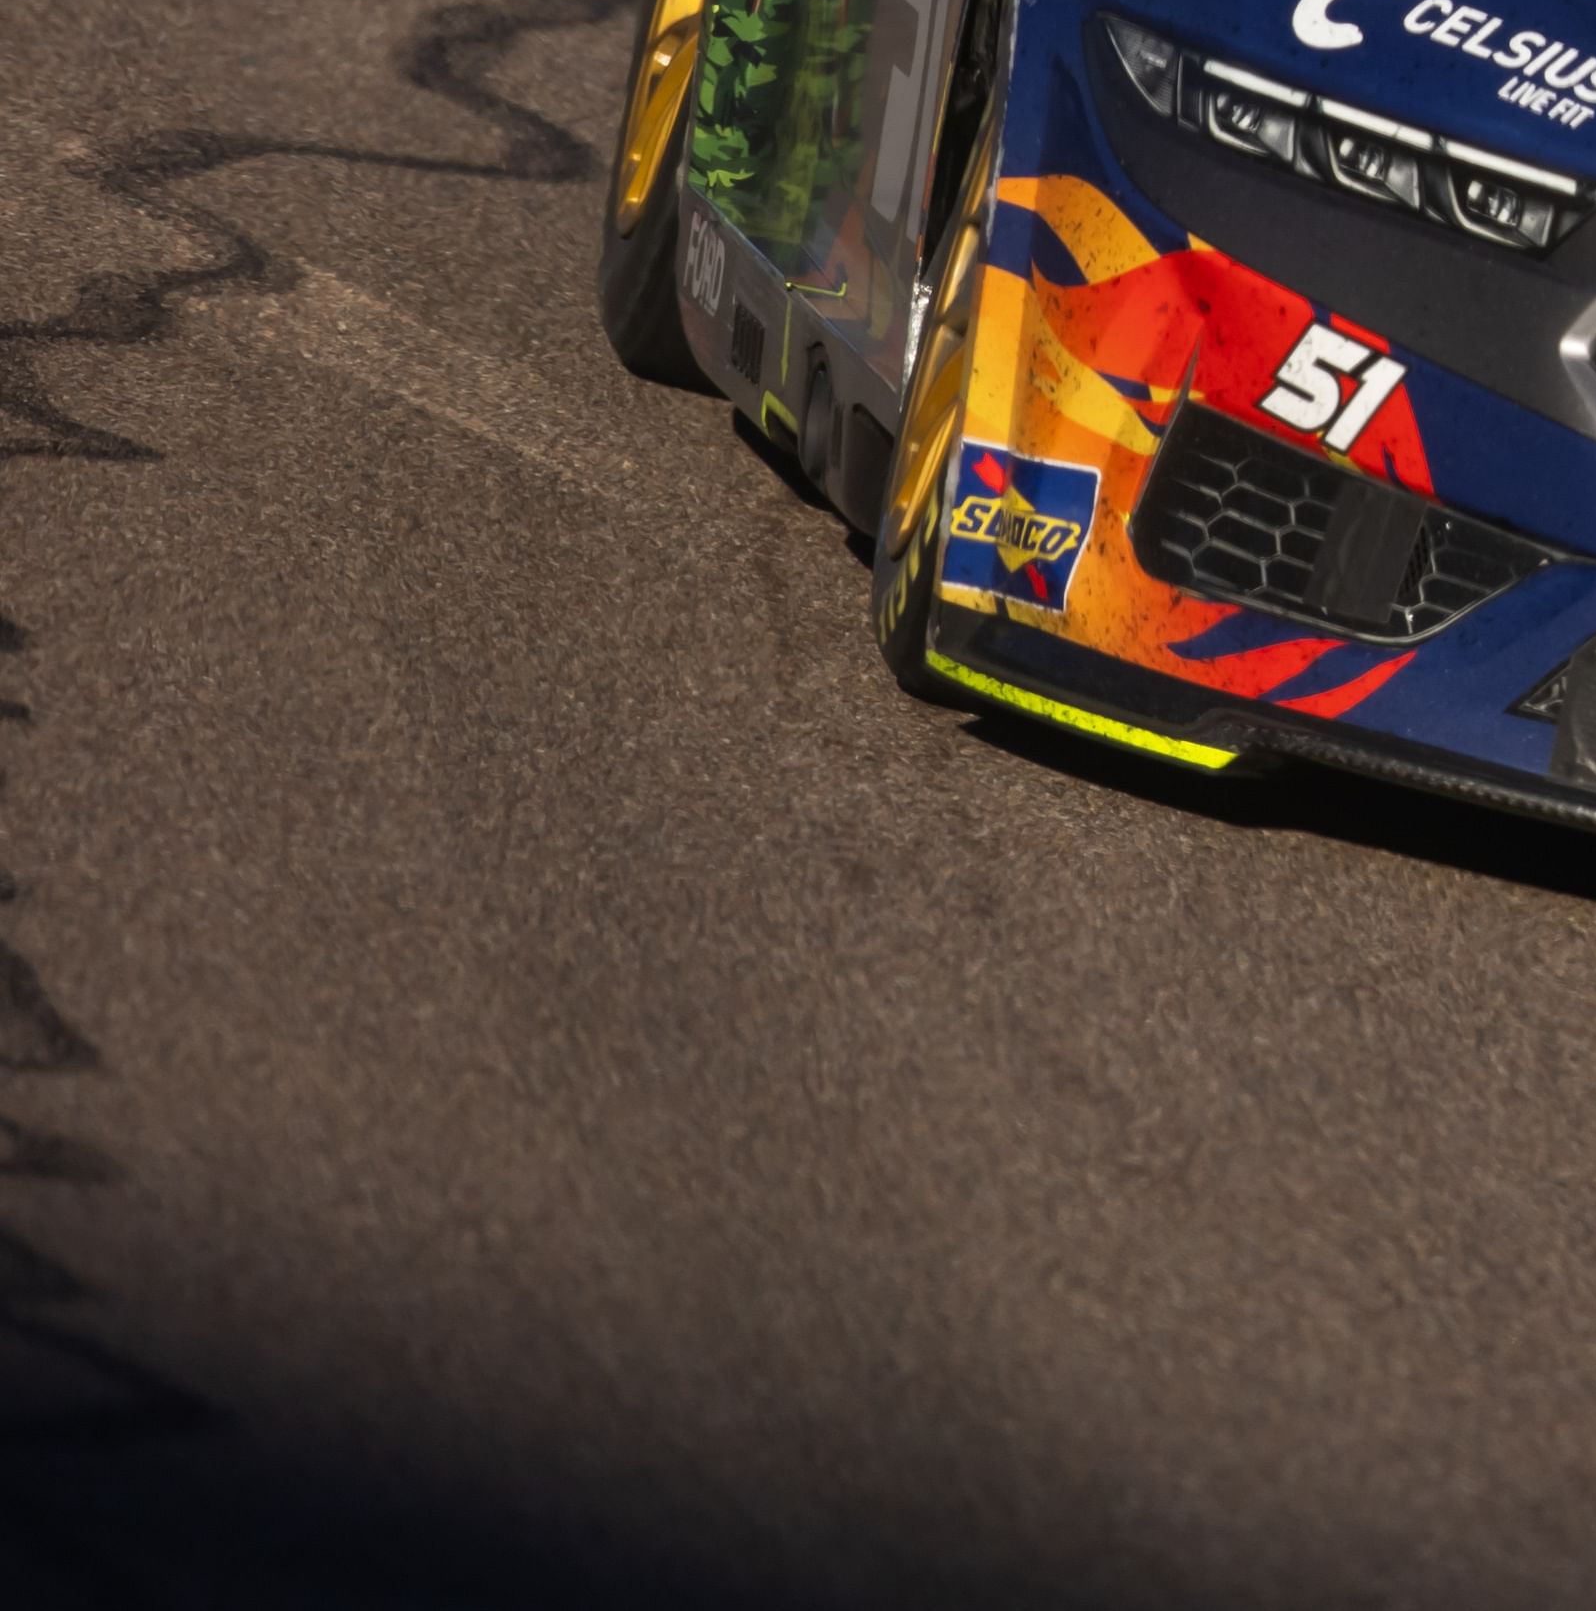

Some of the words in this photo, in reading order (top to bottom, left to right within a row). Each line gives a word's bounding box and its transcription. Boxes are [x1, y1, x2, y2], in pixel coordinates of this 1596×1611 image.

[1498, 76, 1557, 116] LIVE
[1547, 97, 1595, 130] FIT
[682, 211, 725, 317] FORD
[1259, 321, 1408, 454] 51
